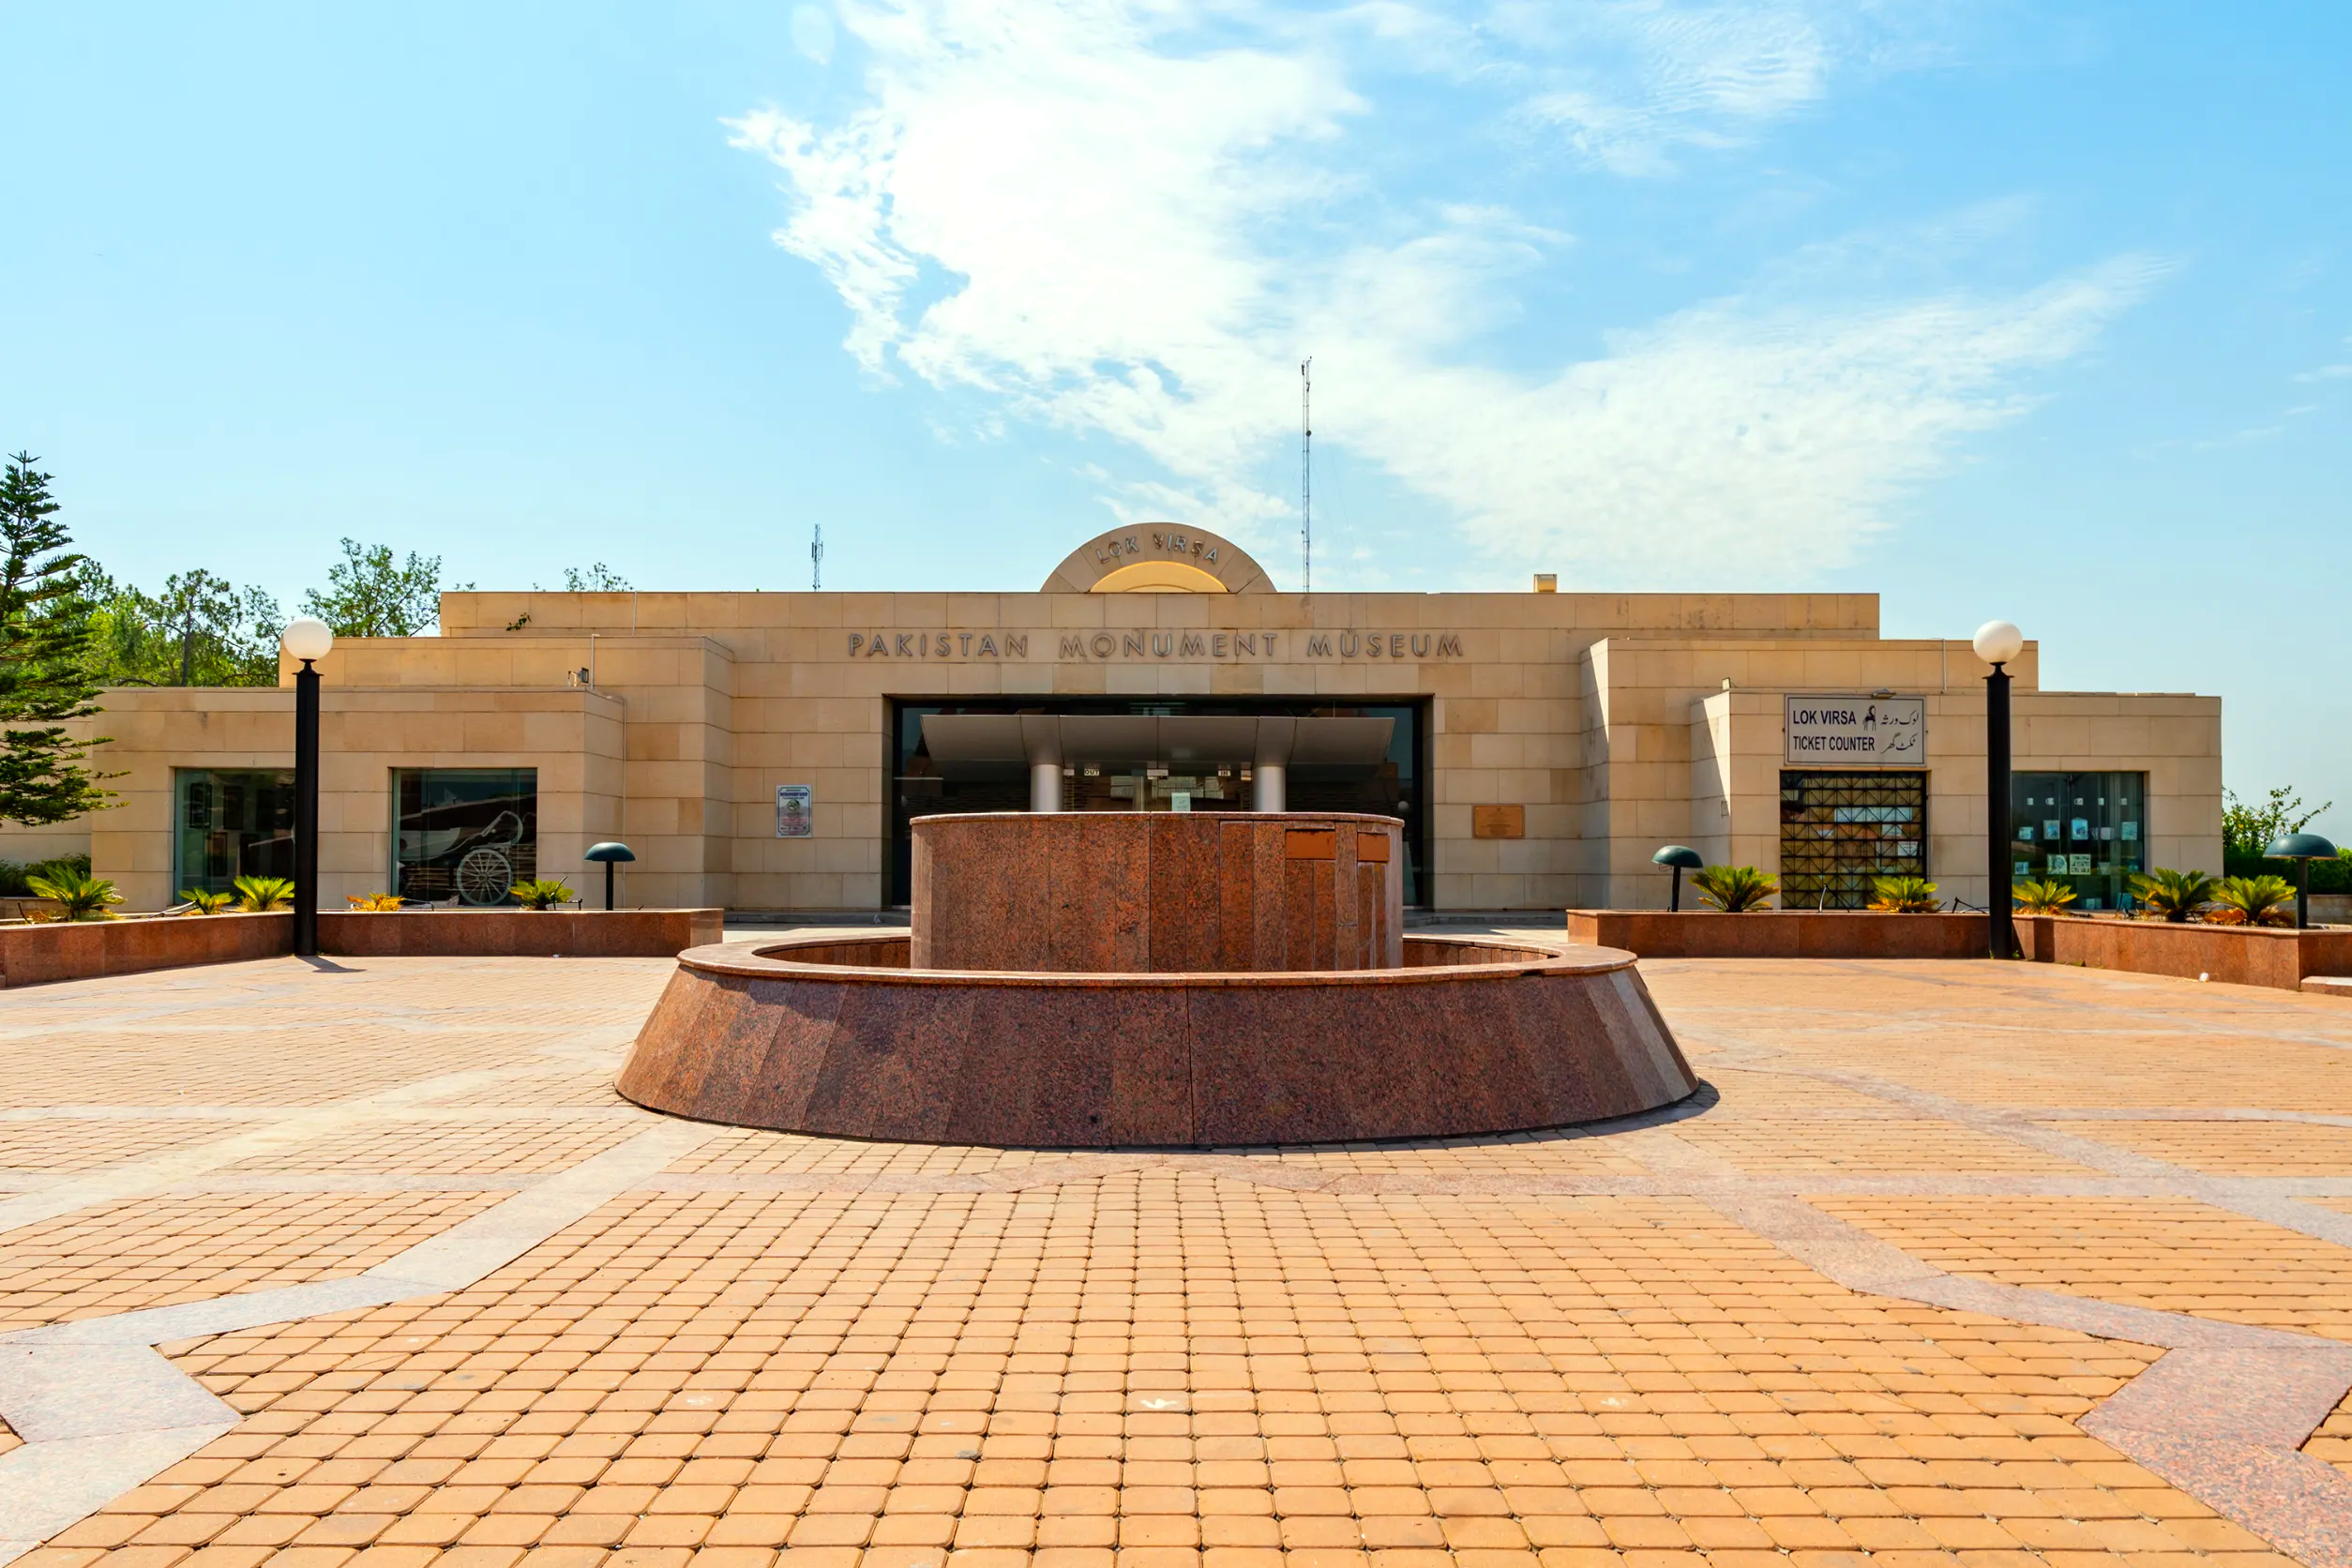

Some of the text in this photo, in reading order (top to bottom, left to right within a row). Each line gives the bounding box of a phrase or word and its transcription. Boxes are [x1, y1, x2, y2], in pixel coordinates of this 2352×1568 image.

[1095, 533, 1219, 565] LOK VIRSA
[848, 633, 1464, 658] PAKISTAN MONUMENT MUSEUM
[1793, 710, 1857, 726] LOK VIRSA
[1793, 735, 1876, 751] TICKET COUNTER
